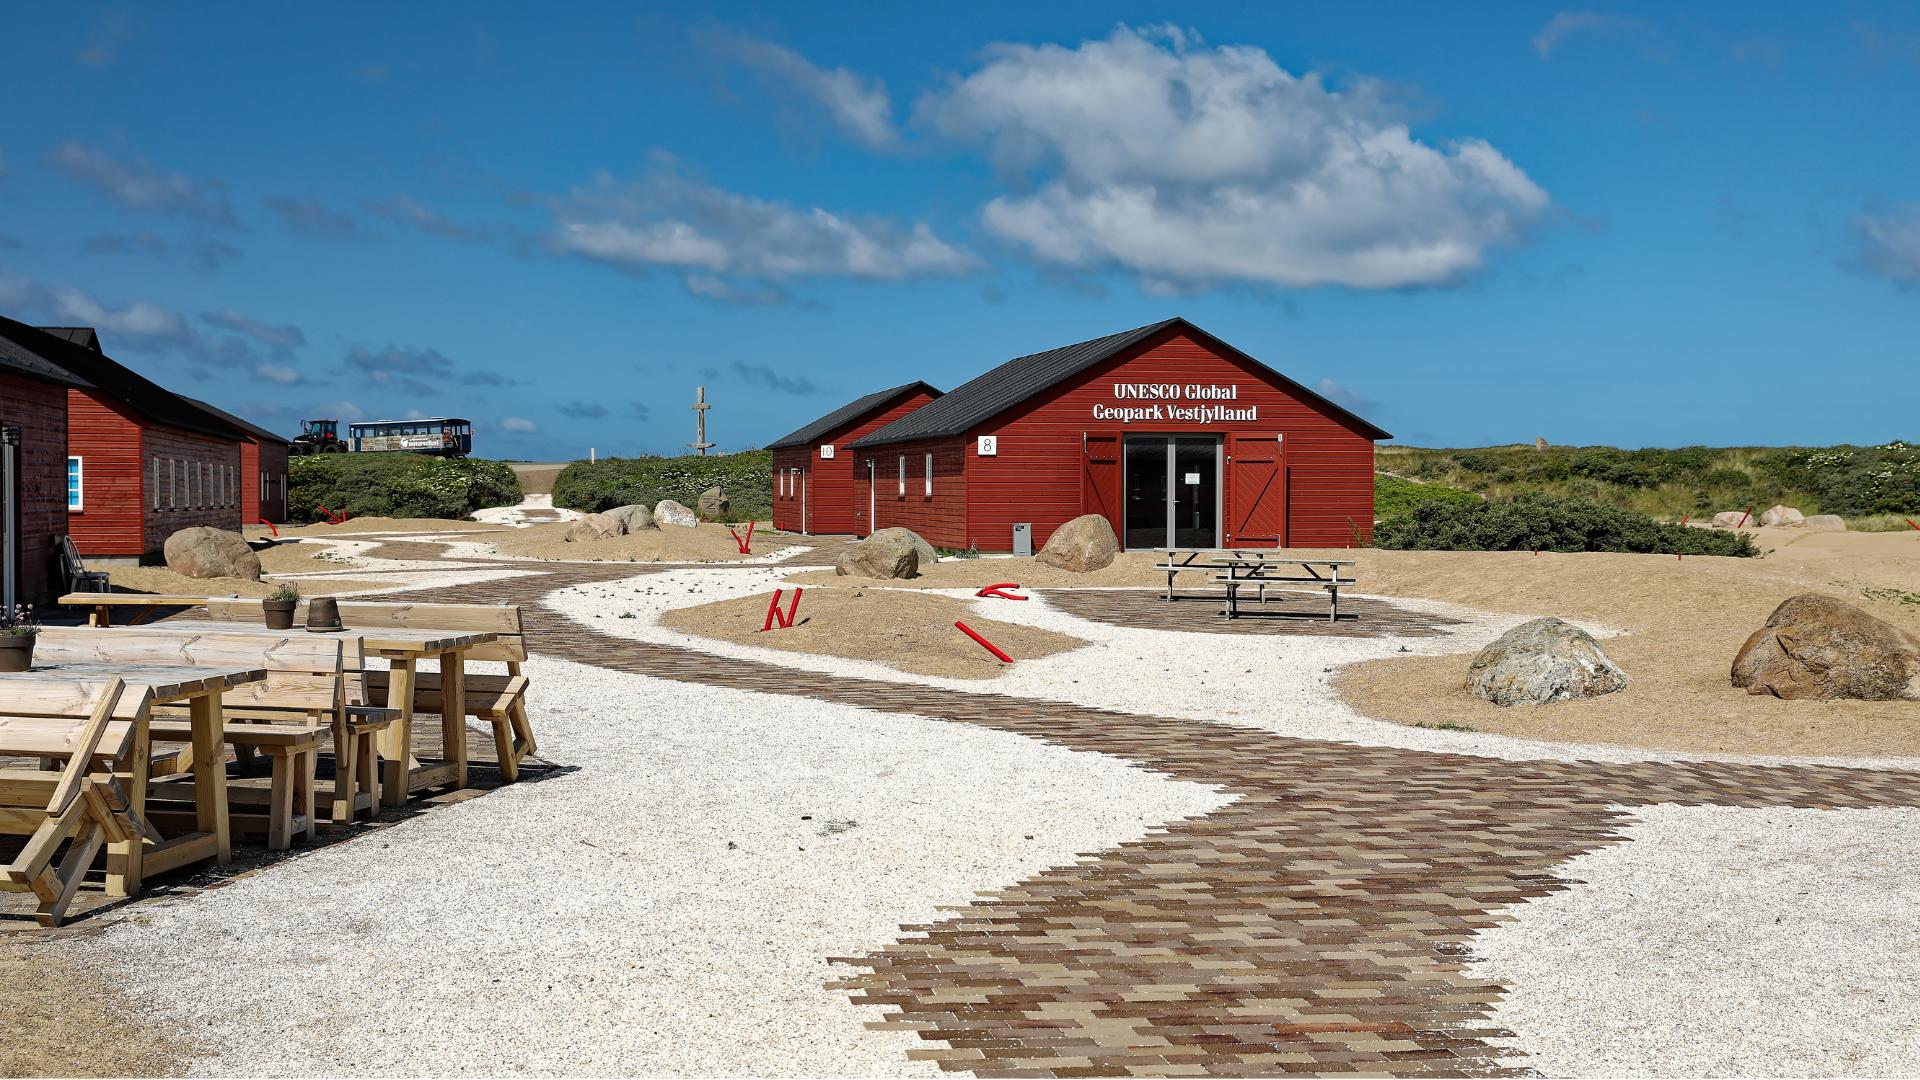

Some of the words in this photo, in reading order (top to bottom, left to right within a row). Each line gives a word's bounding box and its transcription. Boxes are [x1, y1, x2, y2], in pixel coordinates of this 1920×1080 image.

[1114, 383, 1181, 399] UNESCO
[1185, 384, 1237, 400] Global
[1093, 403, 1164, 423] Geopark
[1166, 404, 1257, 424] Vestjylland
[822, 446, 833, 457] 10
[983, 438, 992, 452] 8
